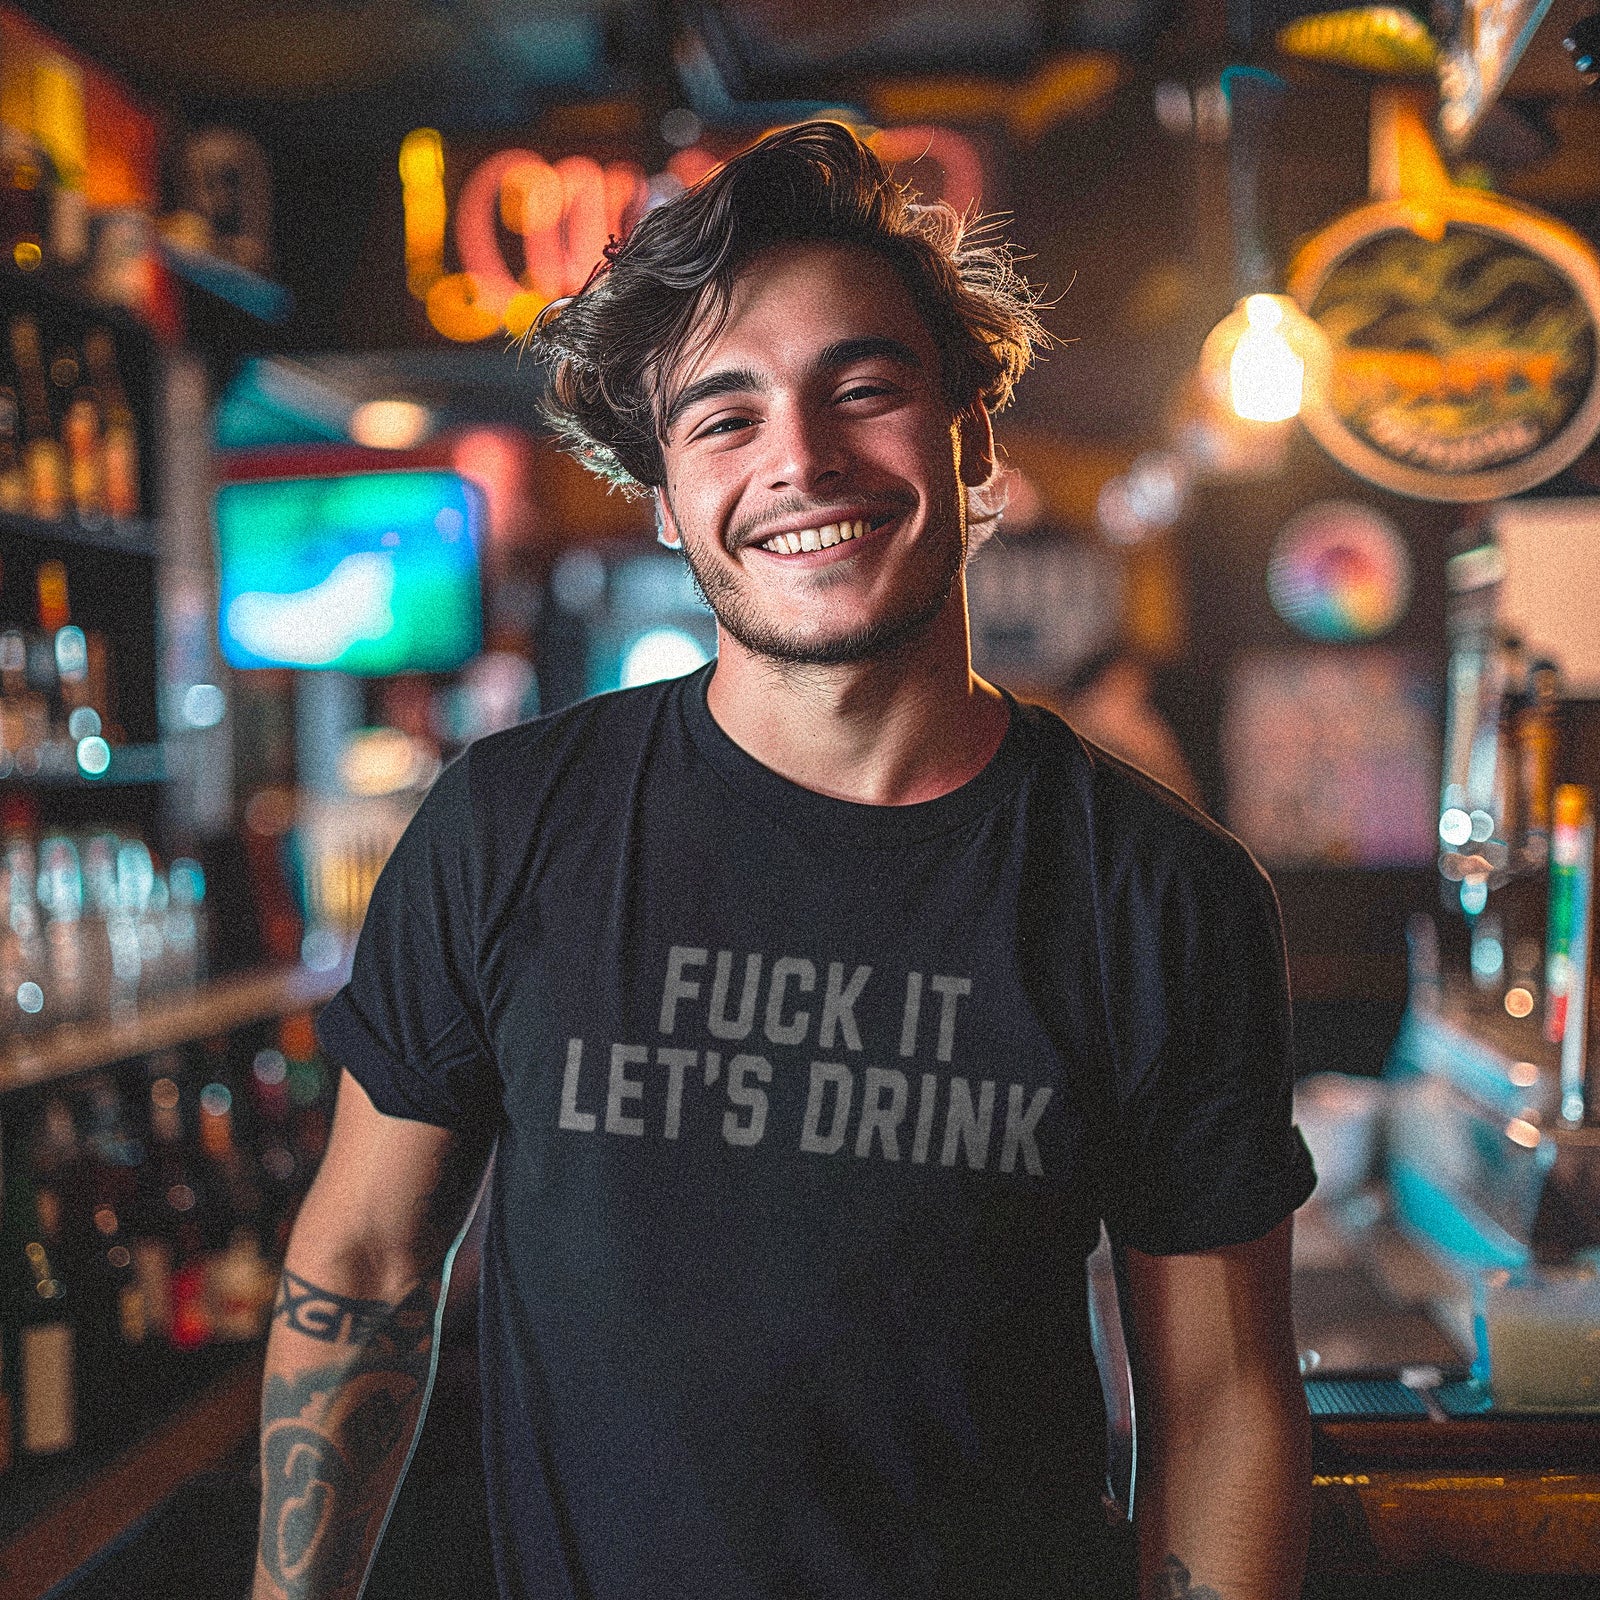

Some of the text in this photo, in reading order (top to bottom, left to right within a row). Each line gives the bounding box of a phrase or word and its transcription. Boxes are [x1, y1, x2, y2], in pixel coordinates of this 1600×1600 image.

[659, 946, 972, 1061] FUCK IT
[559, 1039, 1053, 1176] LET'S DRINK
